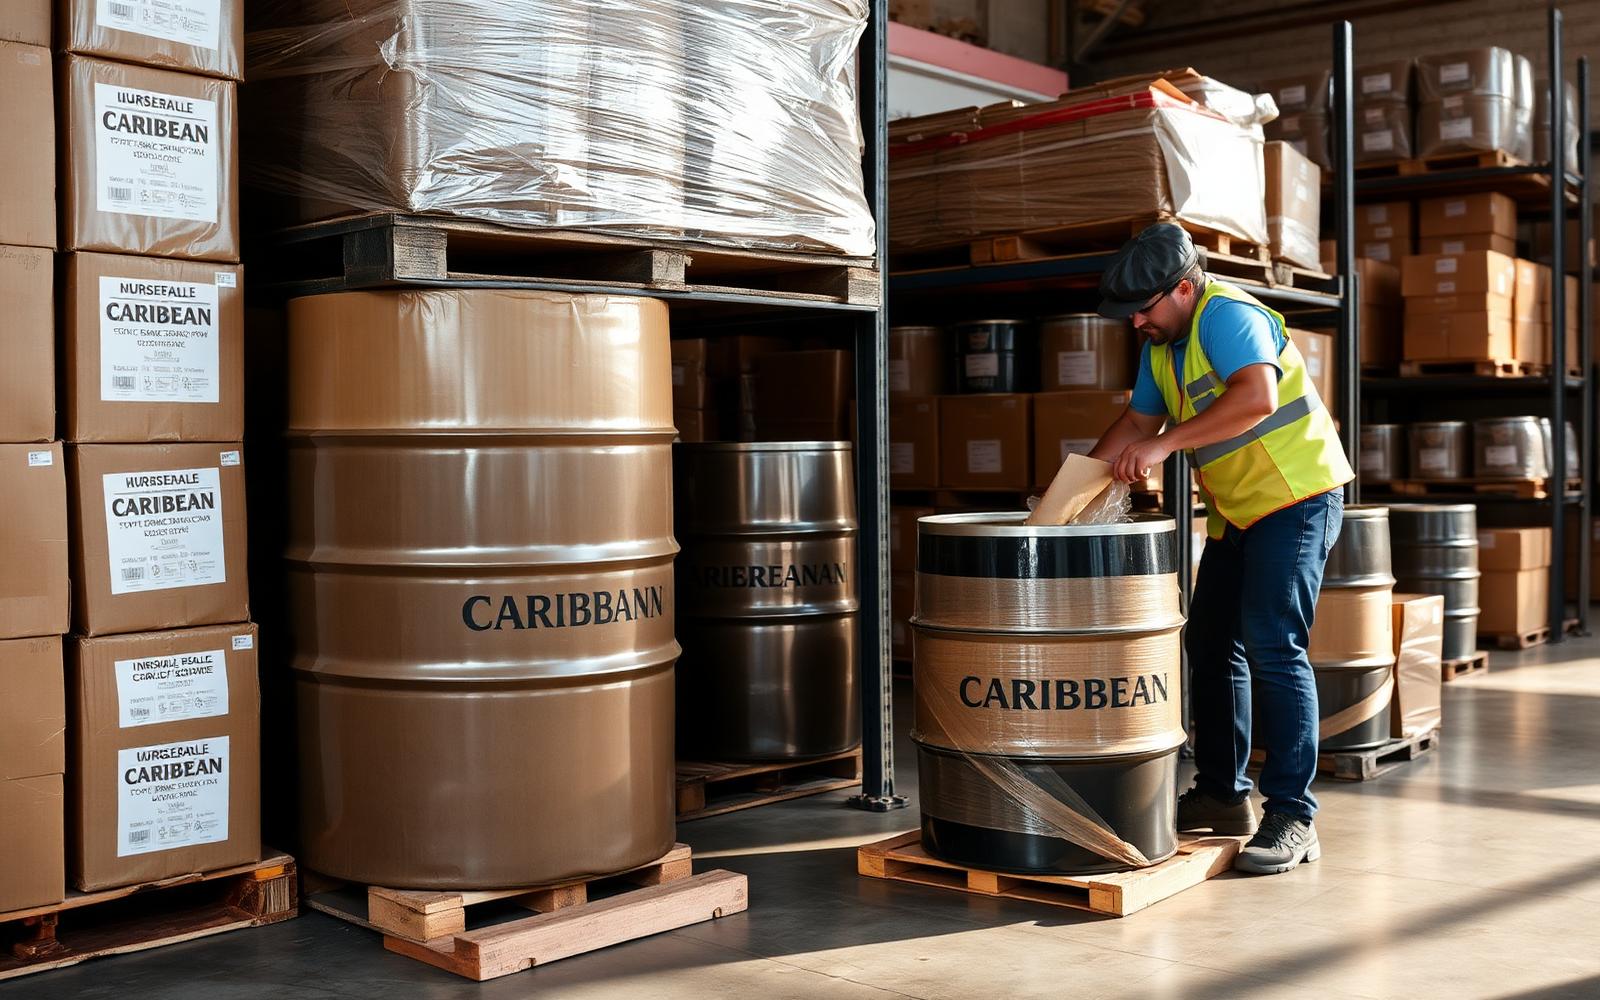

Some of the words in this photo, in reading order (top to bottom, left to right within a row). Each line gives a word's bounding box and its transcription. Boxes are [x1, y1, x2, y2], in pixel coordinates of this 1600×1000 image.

[102, 110, 209, 144] CARIBEAN
[106, 302, 211, 326] CARIBEAN
[462, 585, 664, 632] CARIBBANN
[959, 672, 1168, 711] CARIBBEAN
[124, 757, 222, 785] CARIBEAN
